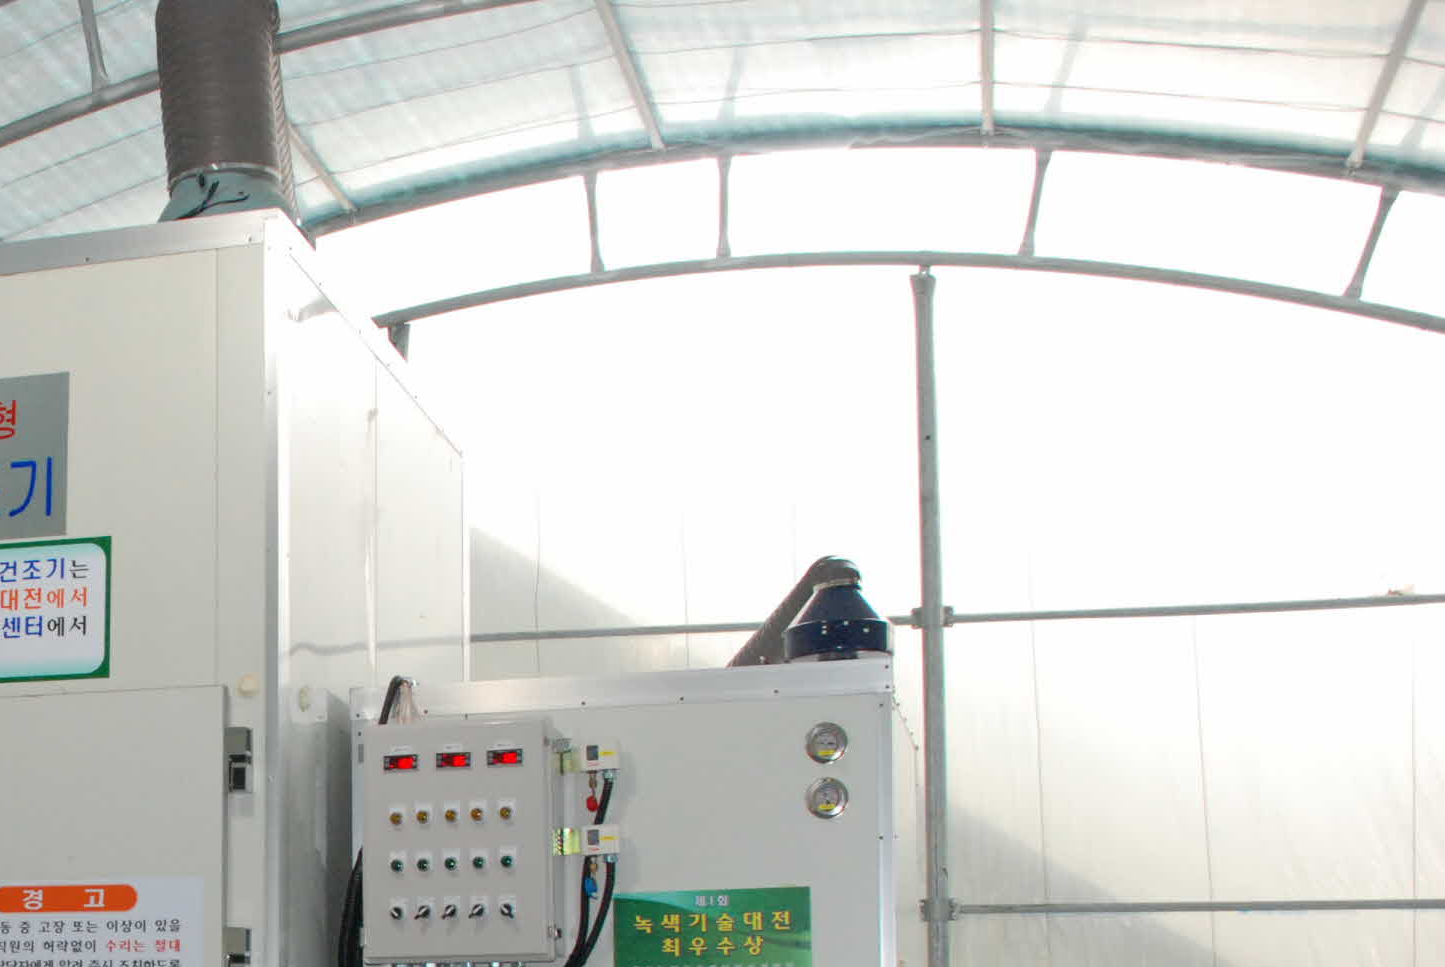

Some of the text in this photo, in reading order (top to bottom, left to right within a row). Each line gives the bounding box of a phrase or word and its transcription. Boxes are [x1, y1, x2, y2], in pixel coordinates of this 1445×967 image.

[19, 920, 31, 935] 중
[38, 921, 66, 935] 고장
[71, 920, 98, 933] 또는
[105, 919, 147, 933] 이상이
[154, 918, 181, 933] 있을
[43, 939, 96, 953] 허락없이
[106, 939, 149, 953] 수리는
[155, 938, 181, 952] 절대
